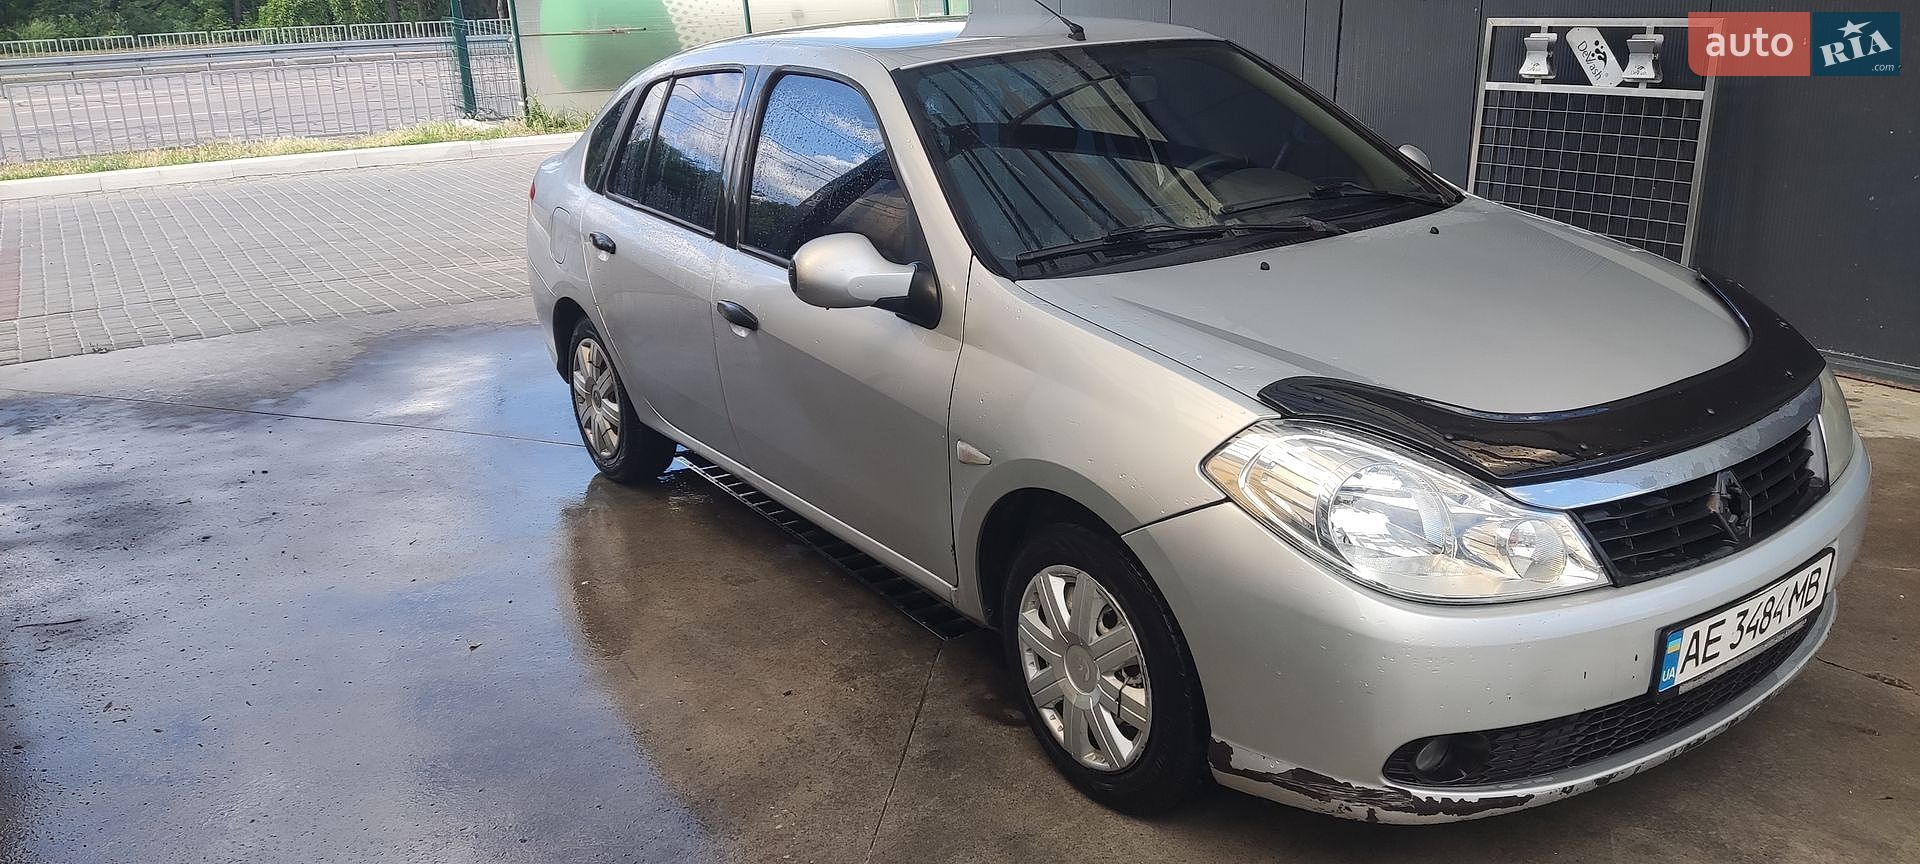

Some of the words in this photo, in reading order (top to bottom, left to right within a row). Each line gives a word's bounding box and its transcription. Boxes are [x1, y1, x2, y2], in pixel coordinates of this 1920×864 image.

[1679, 619, 1726, 674] AE
[1729, 585, 1788, 650] 3484
[1787, 567, 1821, 618] MB
[1662, 666, 1675, 682] UA
